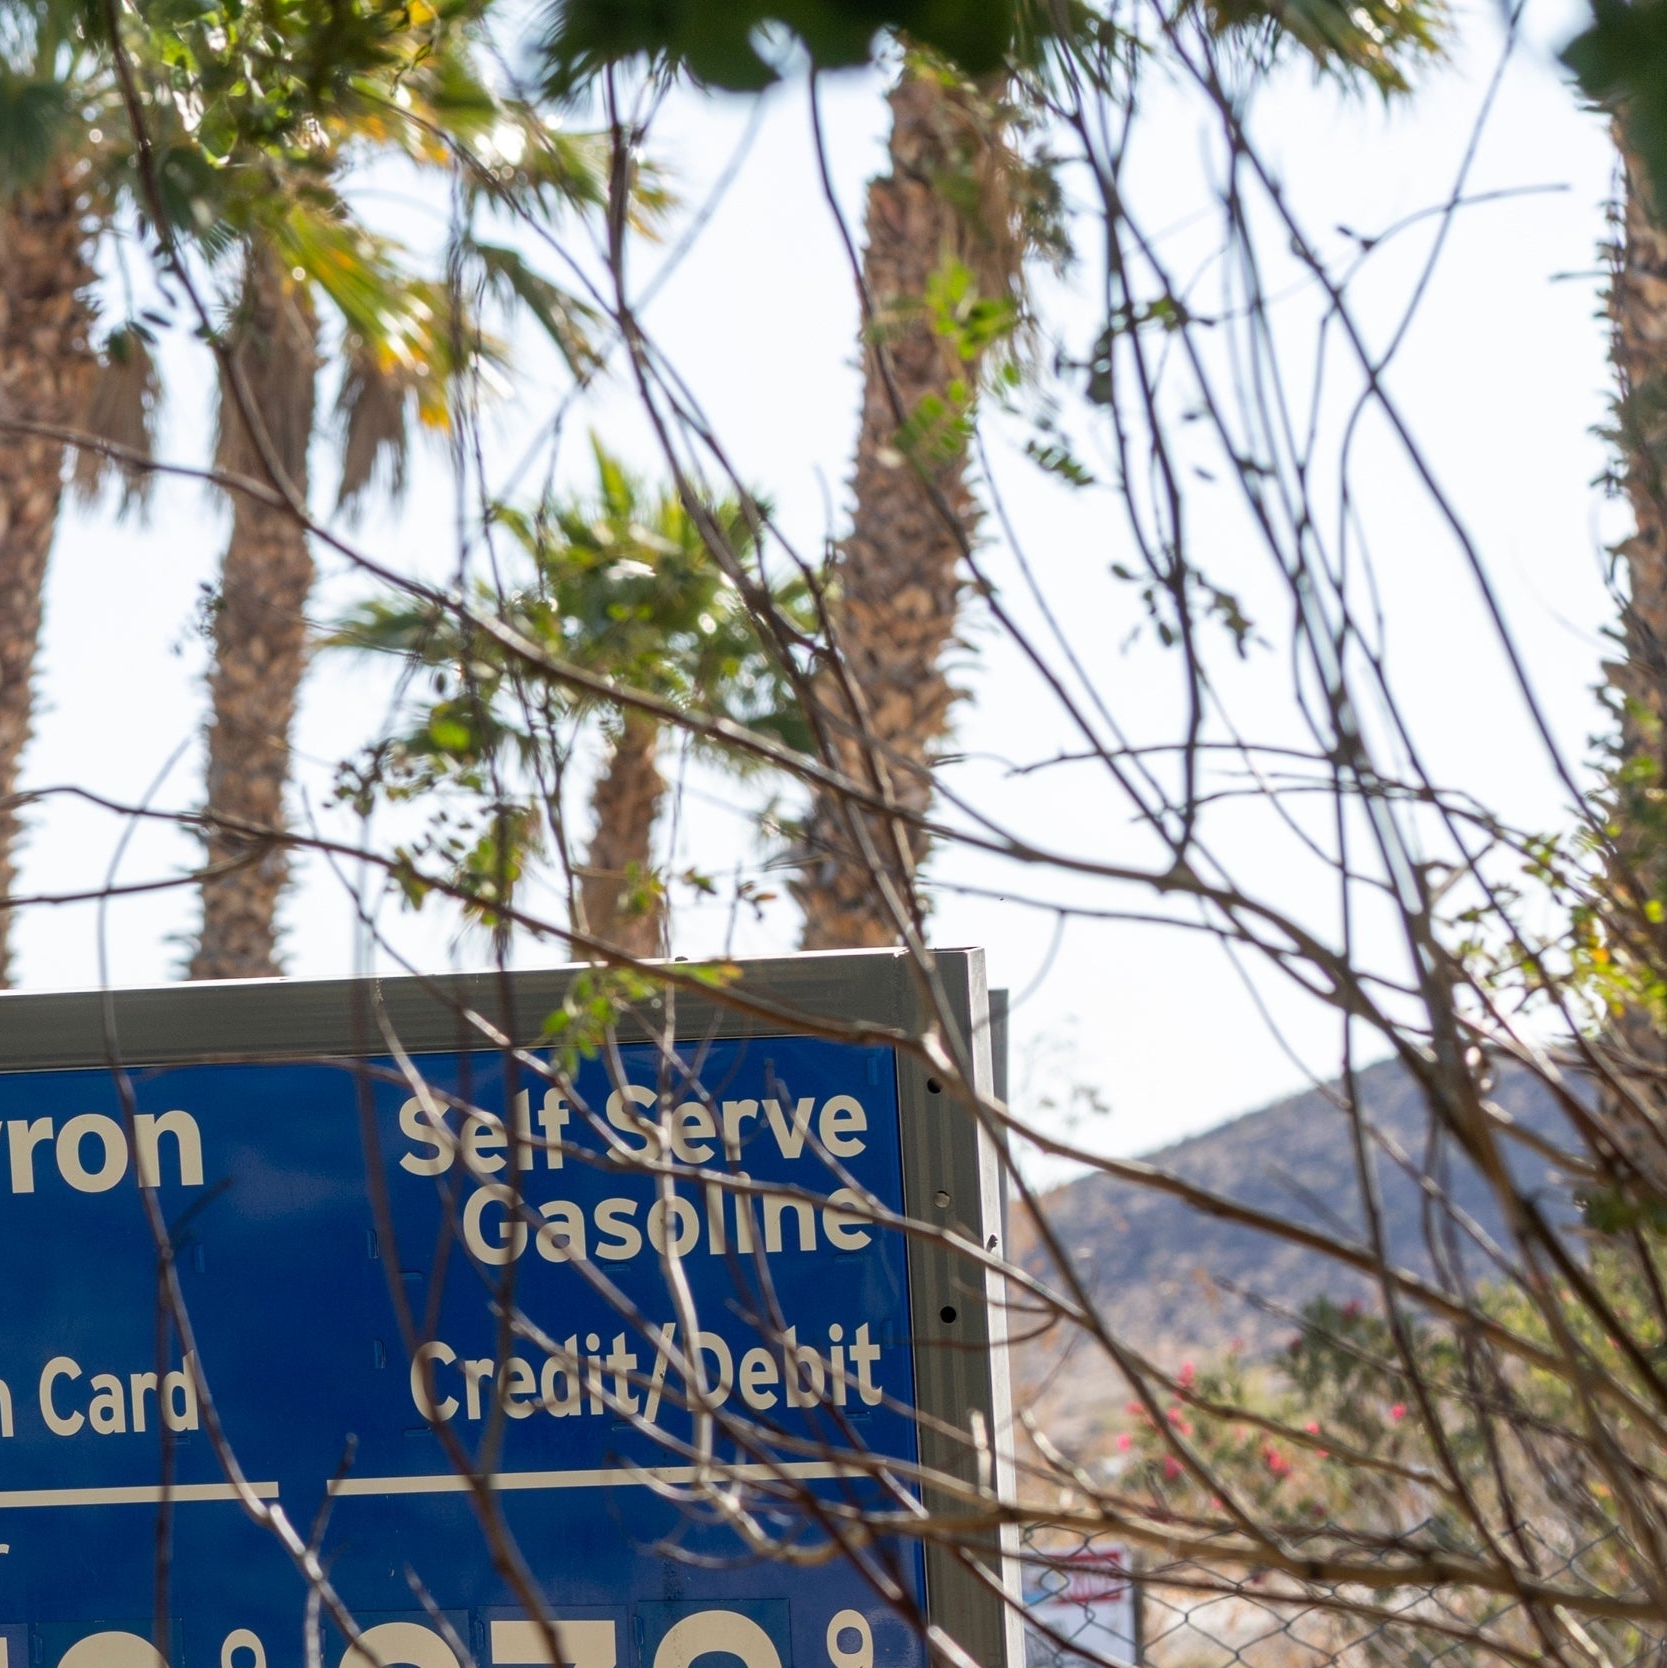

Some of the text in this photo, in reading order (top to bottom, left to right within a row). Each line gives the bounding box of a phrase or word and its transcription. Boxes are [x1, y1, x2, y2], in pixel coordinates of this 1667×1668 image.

[400, 1085, 867, 1176] Self Serve
[463, 1173, 874, 1265] Gasoline
[40, 1350, 198, 1435] Card
[411, 1322, 882, 1423] Credit/Debit
